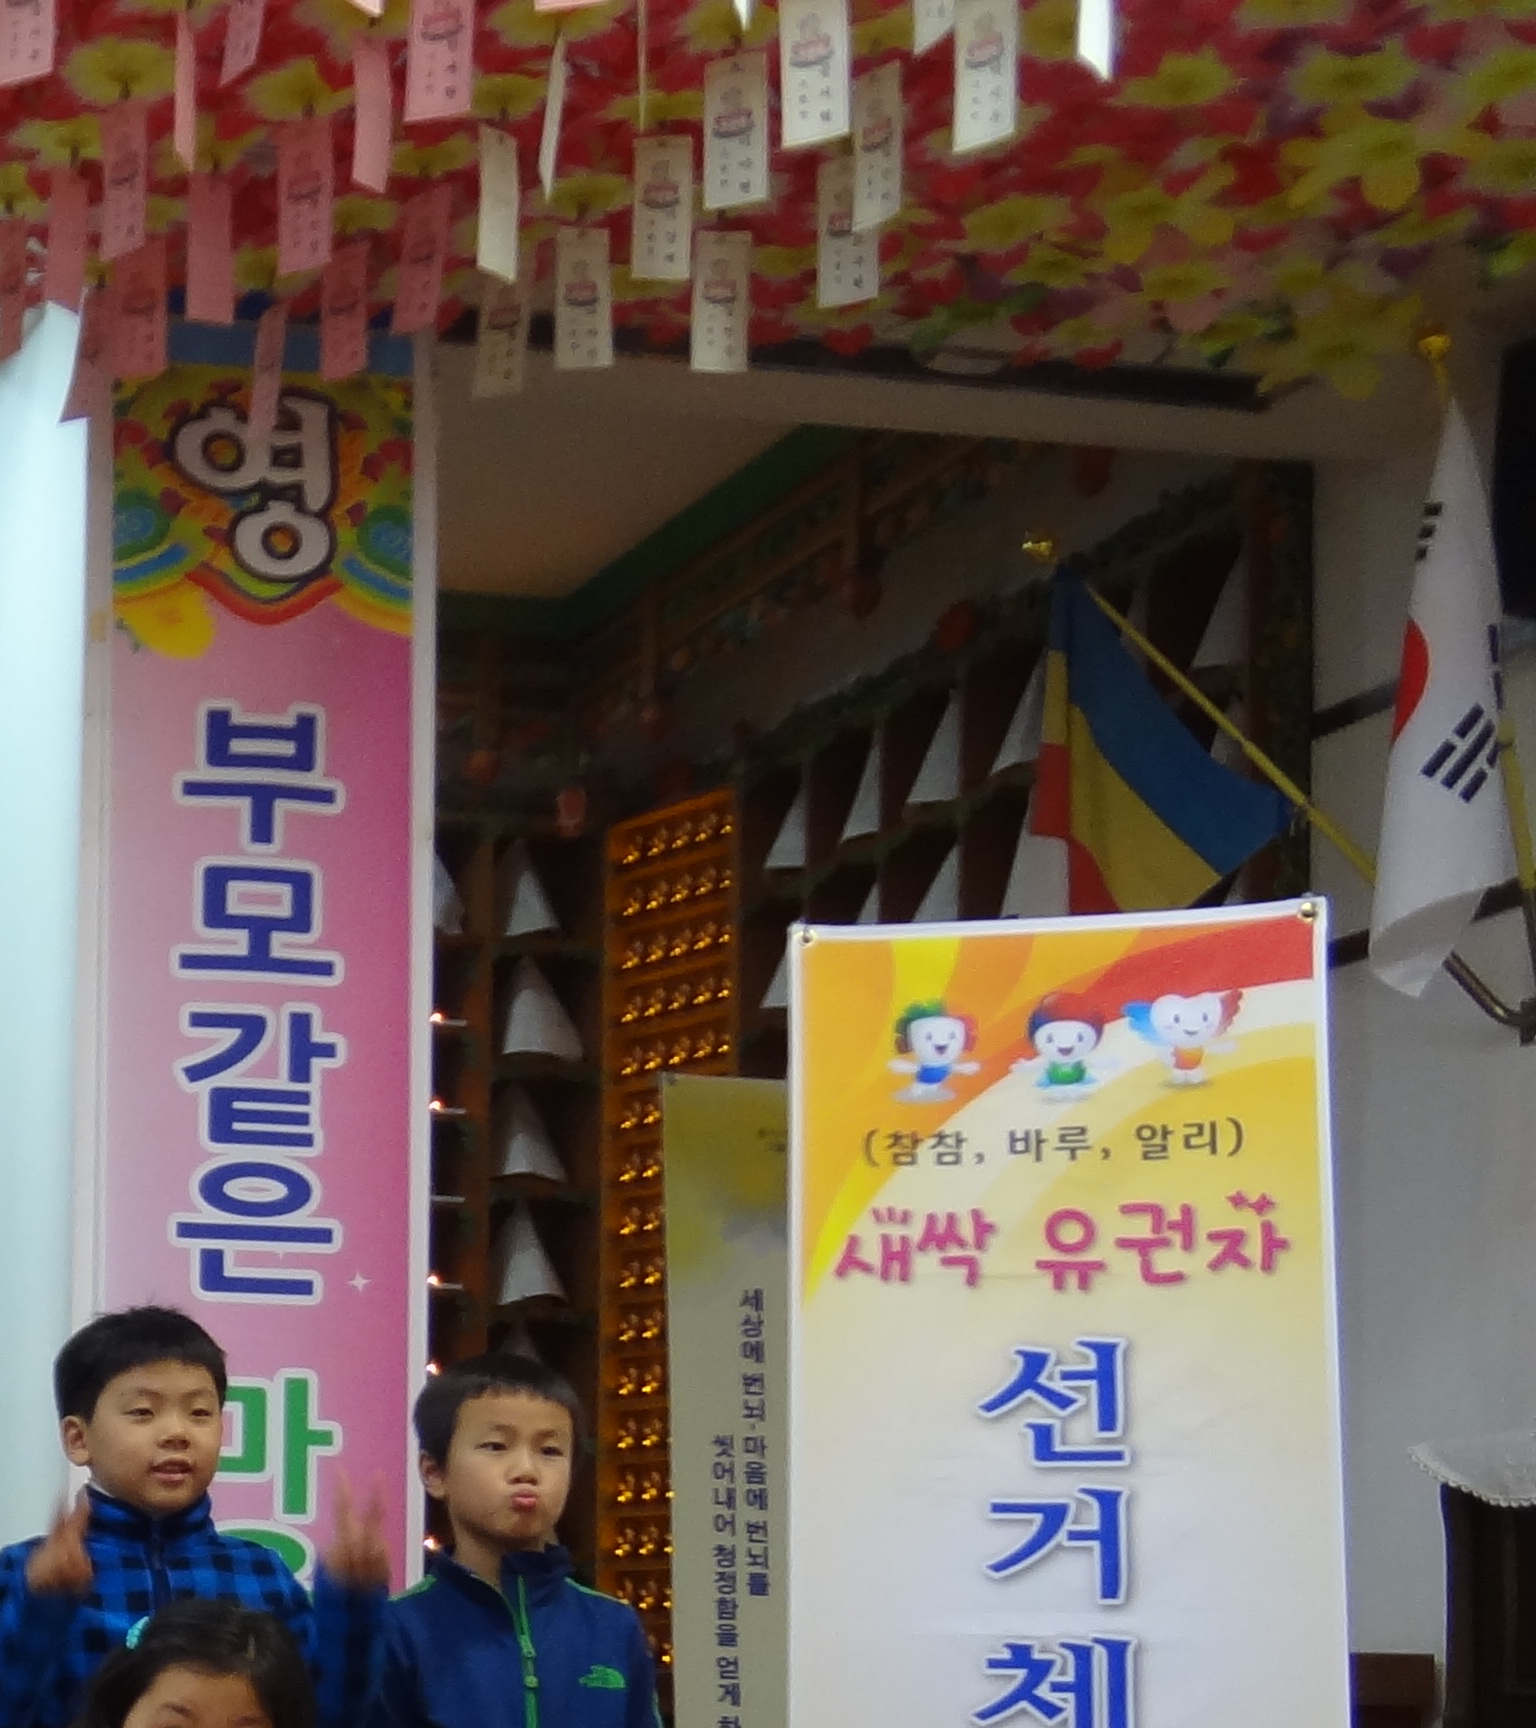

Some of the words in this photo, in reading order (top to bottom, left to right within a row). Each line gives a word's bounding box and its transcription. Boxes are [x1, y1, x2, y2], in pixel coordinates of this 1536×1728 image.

[173, 703, 341, 1302] 부모같은
[862, 1128, 985, 1169] (참참,
[1008, 1124, 1112, 1164] 바루,
[1134, 1117, 1245, 1160] 알리)
[834, 1205, 998, 1290] 새싹
[1034, 1191, 1291, 1293] 유권자
